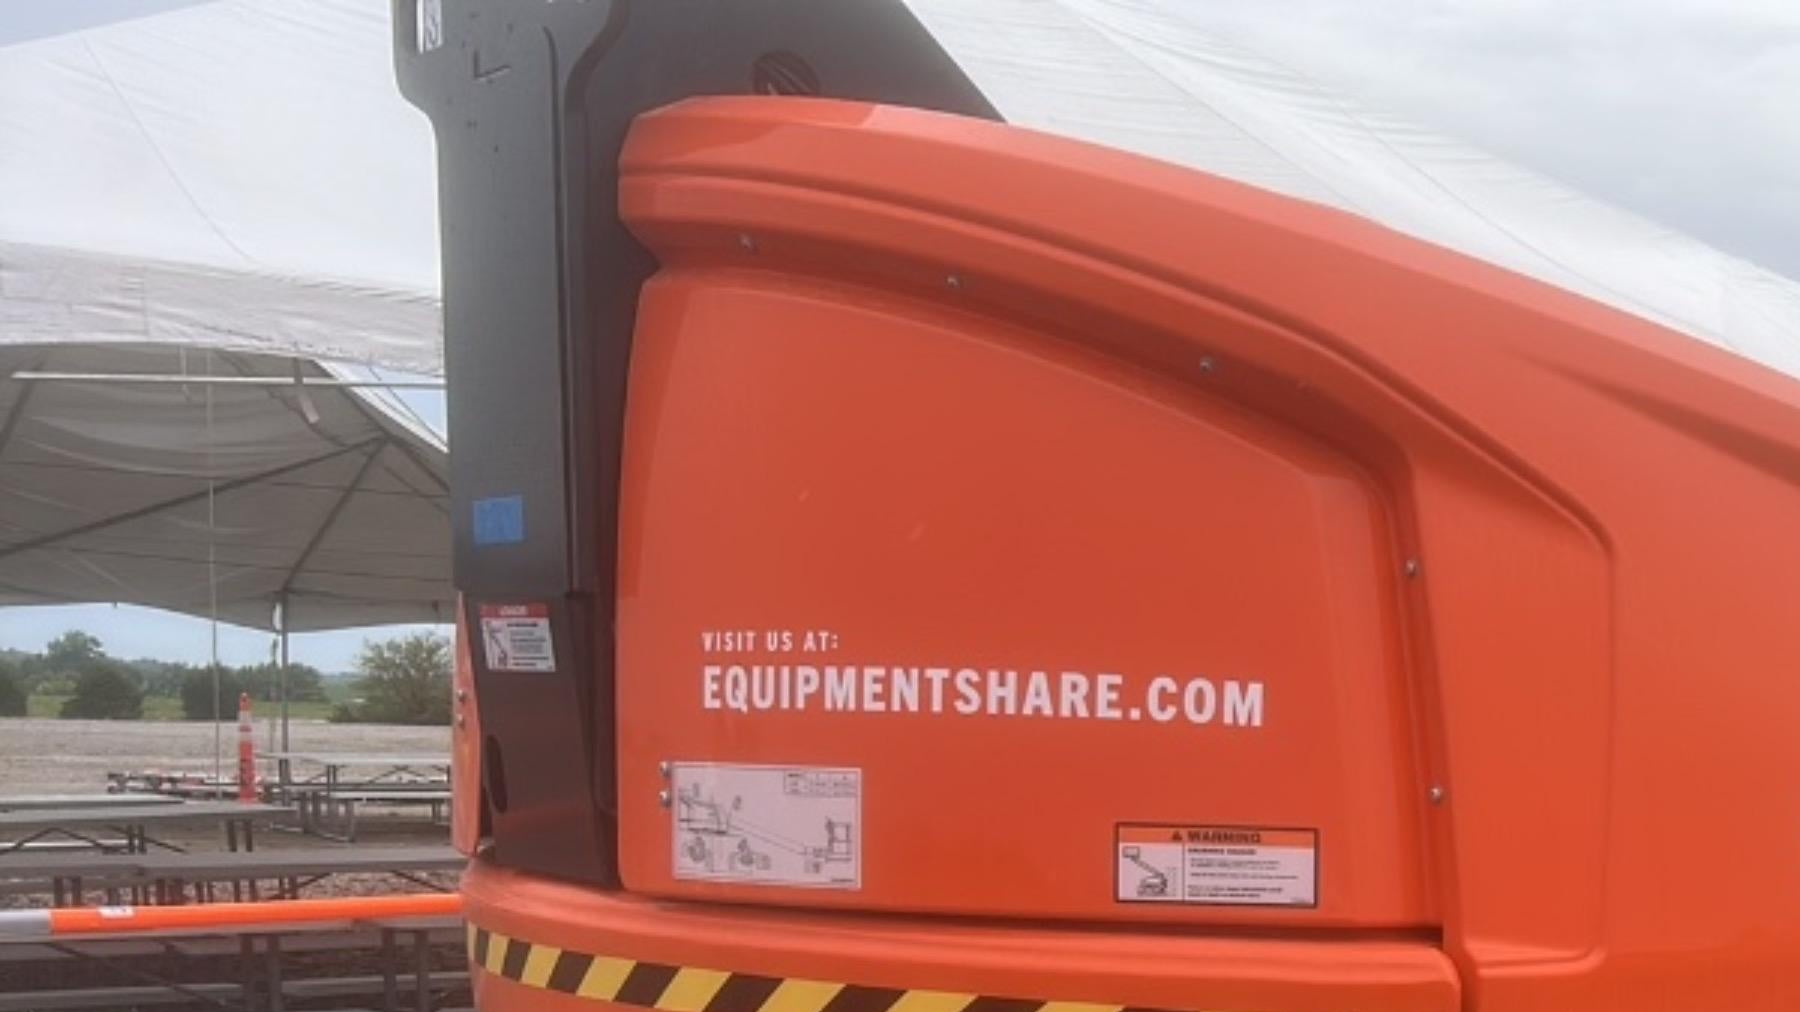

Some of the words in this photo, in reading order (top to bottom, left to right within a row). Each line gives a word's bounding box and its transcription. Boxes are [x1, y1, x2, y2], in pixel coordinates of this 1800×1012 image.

[702, 631, 757, 652] VISIT
[767, 632, 793, 652] US
[803, 632, 838, 652] AT:
[703, 665, 1264, 728] EQUIPMENTSHARE.COM
